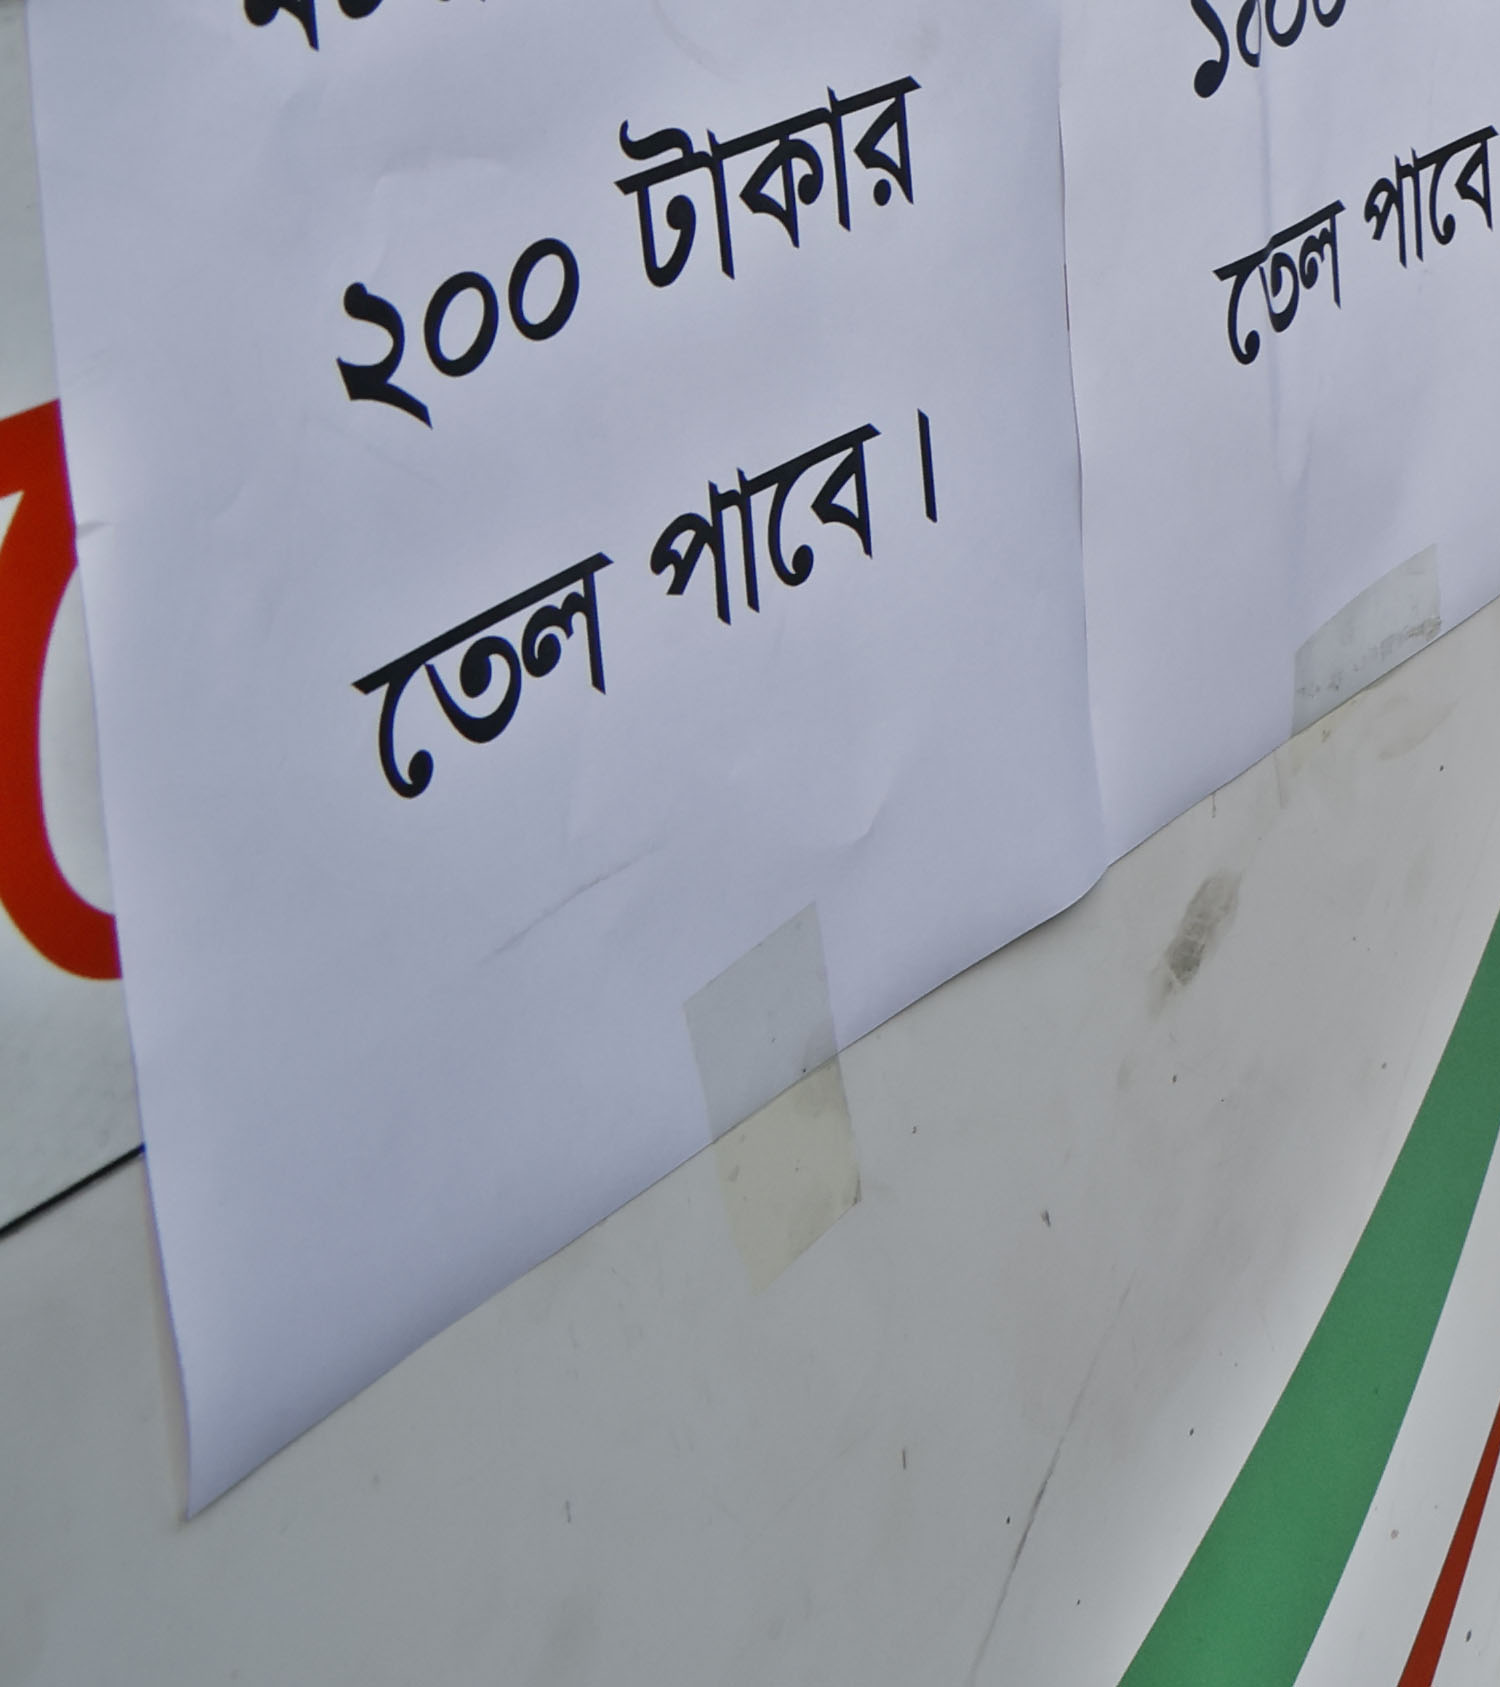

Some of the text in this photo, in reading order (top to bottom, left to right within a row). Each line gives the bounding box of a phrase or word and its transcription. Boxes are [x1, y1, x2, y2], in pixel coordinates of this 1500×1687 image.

[336, 75, 922, 428] ২০০ টাকার
[1212, 199, 1346, 365] তেল
[351, 552, 614, 799] তেল
